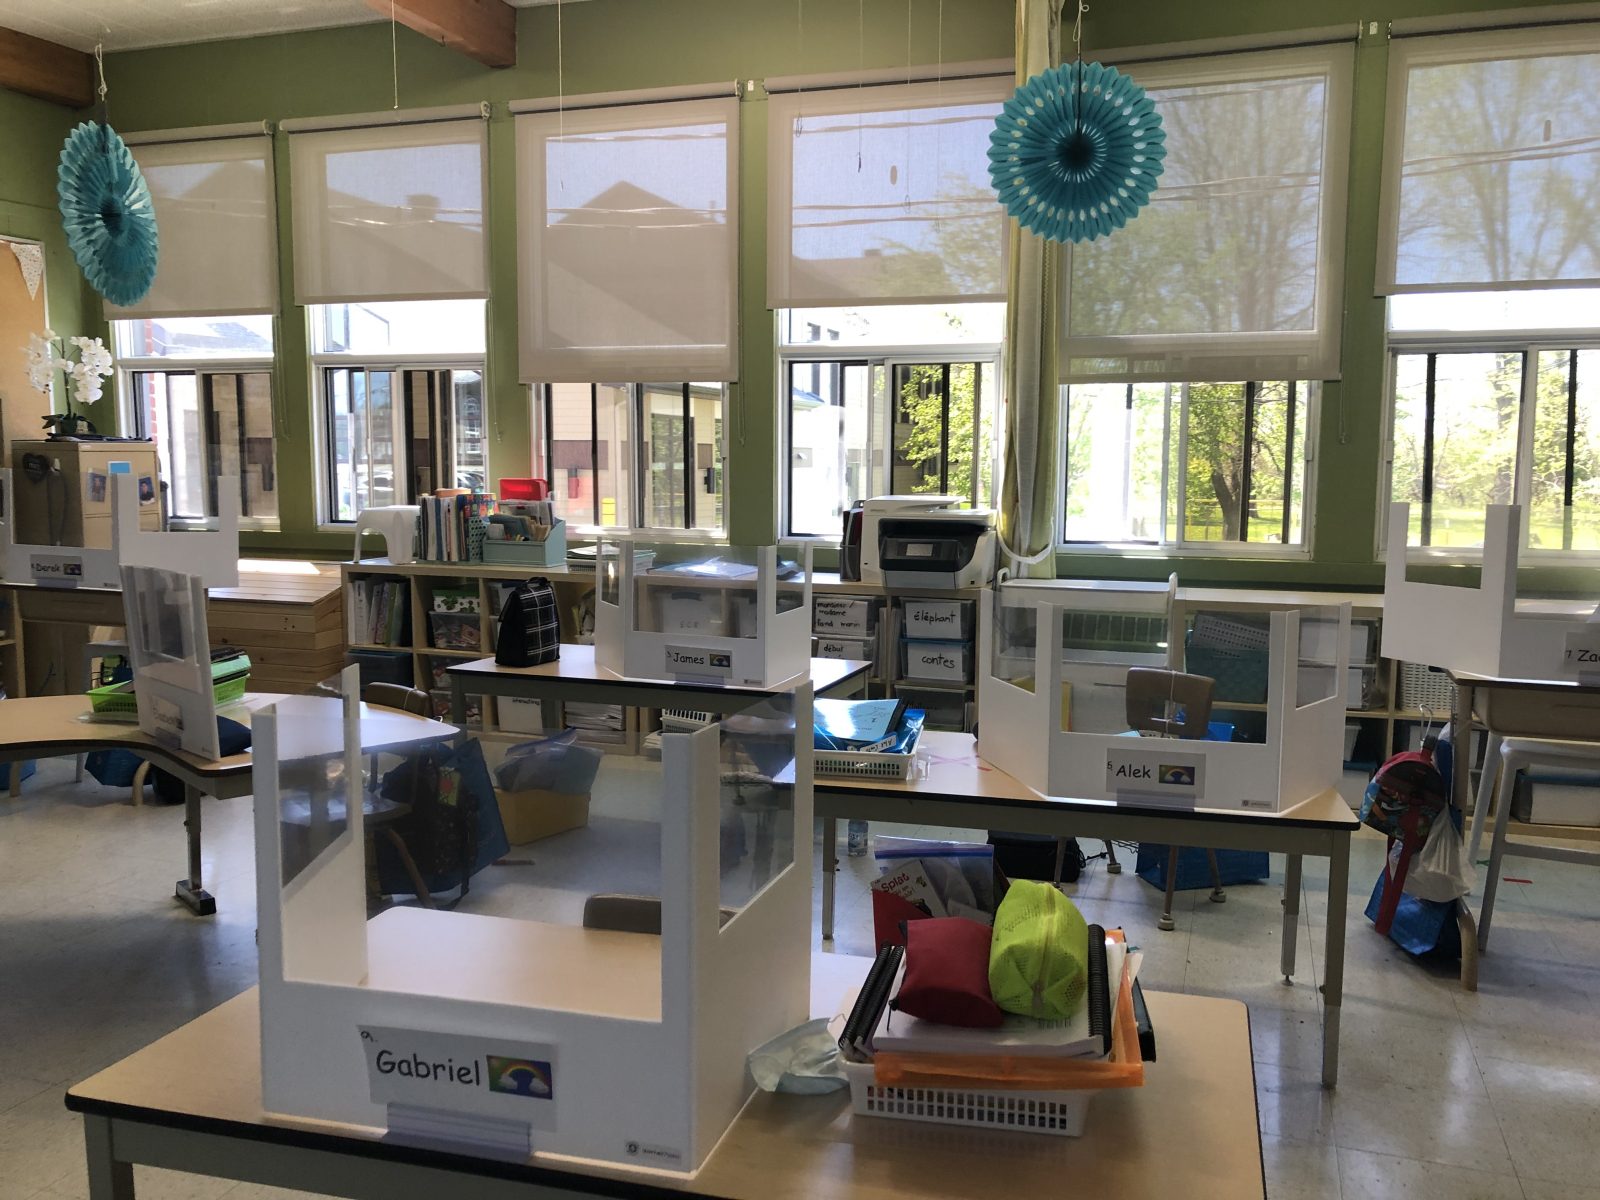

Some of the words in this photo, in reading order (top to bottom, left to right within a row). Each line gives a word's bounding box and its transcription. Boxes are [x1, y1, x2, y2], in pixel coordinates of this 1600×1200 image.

[914, 610, 956, 625] éléphant
[673, 652, 705, 665] James
[921, 652, 956, 669] contes
[1577, 649, 1600, 662] Za
[1115, 763, 1151, 779] Alek
[881, 872, 909, 892] Splat
[376, 1049, 480, 1086] Gabriel
